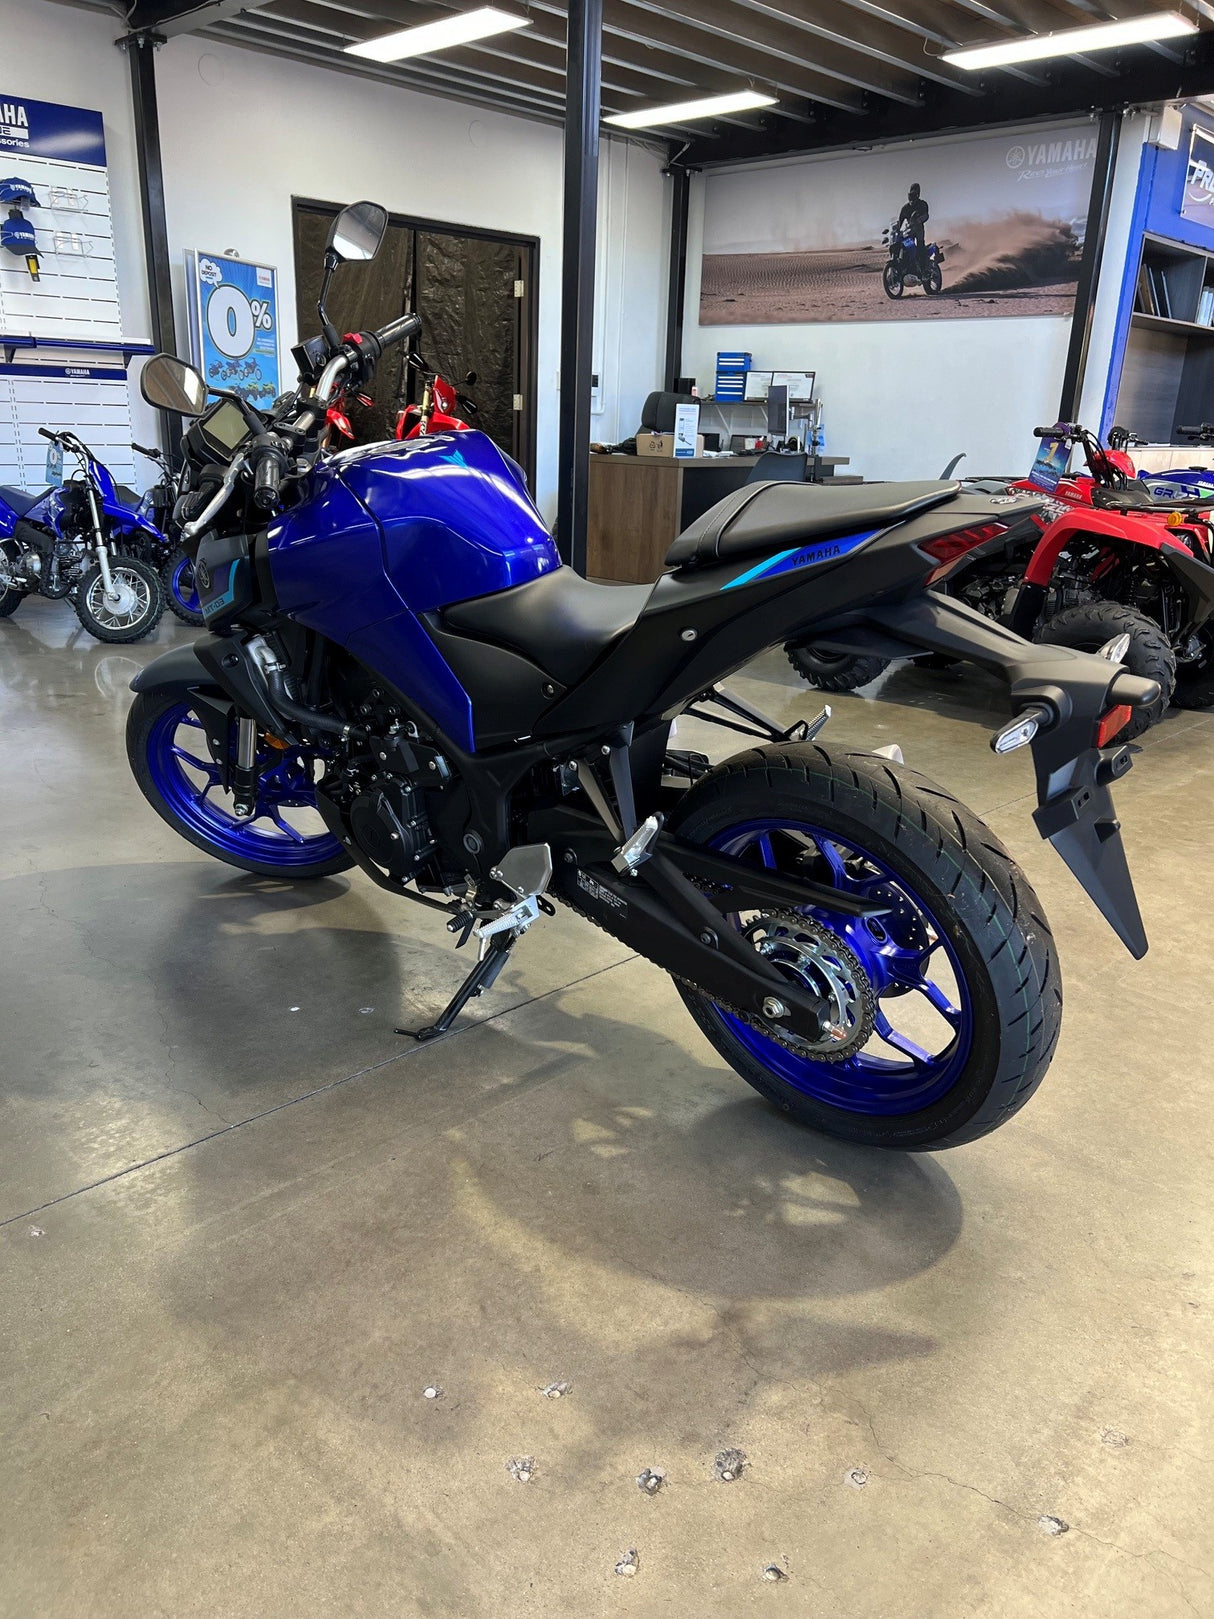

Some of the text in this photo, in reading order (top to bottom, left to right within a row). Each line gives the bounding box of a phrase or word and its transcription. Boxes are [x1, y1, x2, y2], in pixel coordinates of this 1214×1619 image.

[0, 138, 30, 147] sories
[1028, 138, 1096, 165] YAMAHA
[791, 545, 841, 566] YAMAHA
